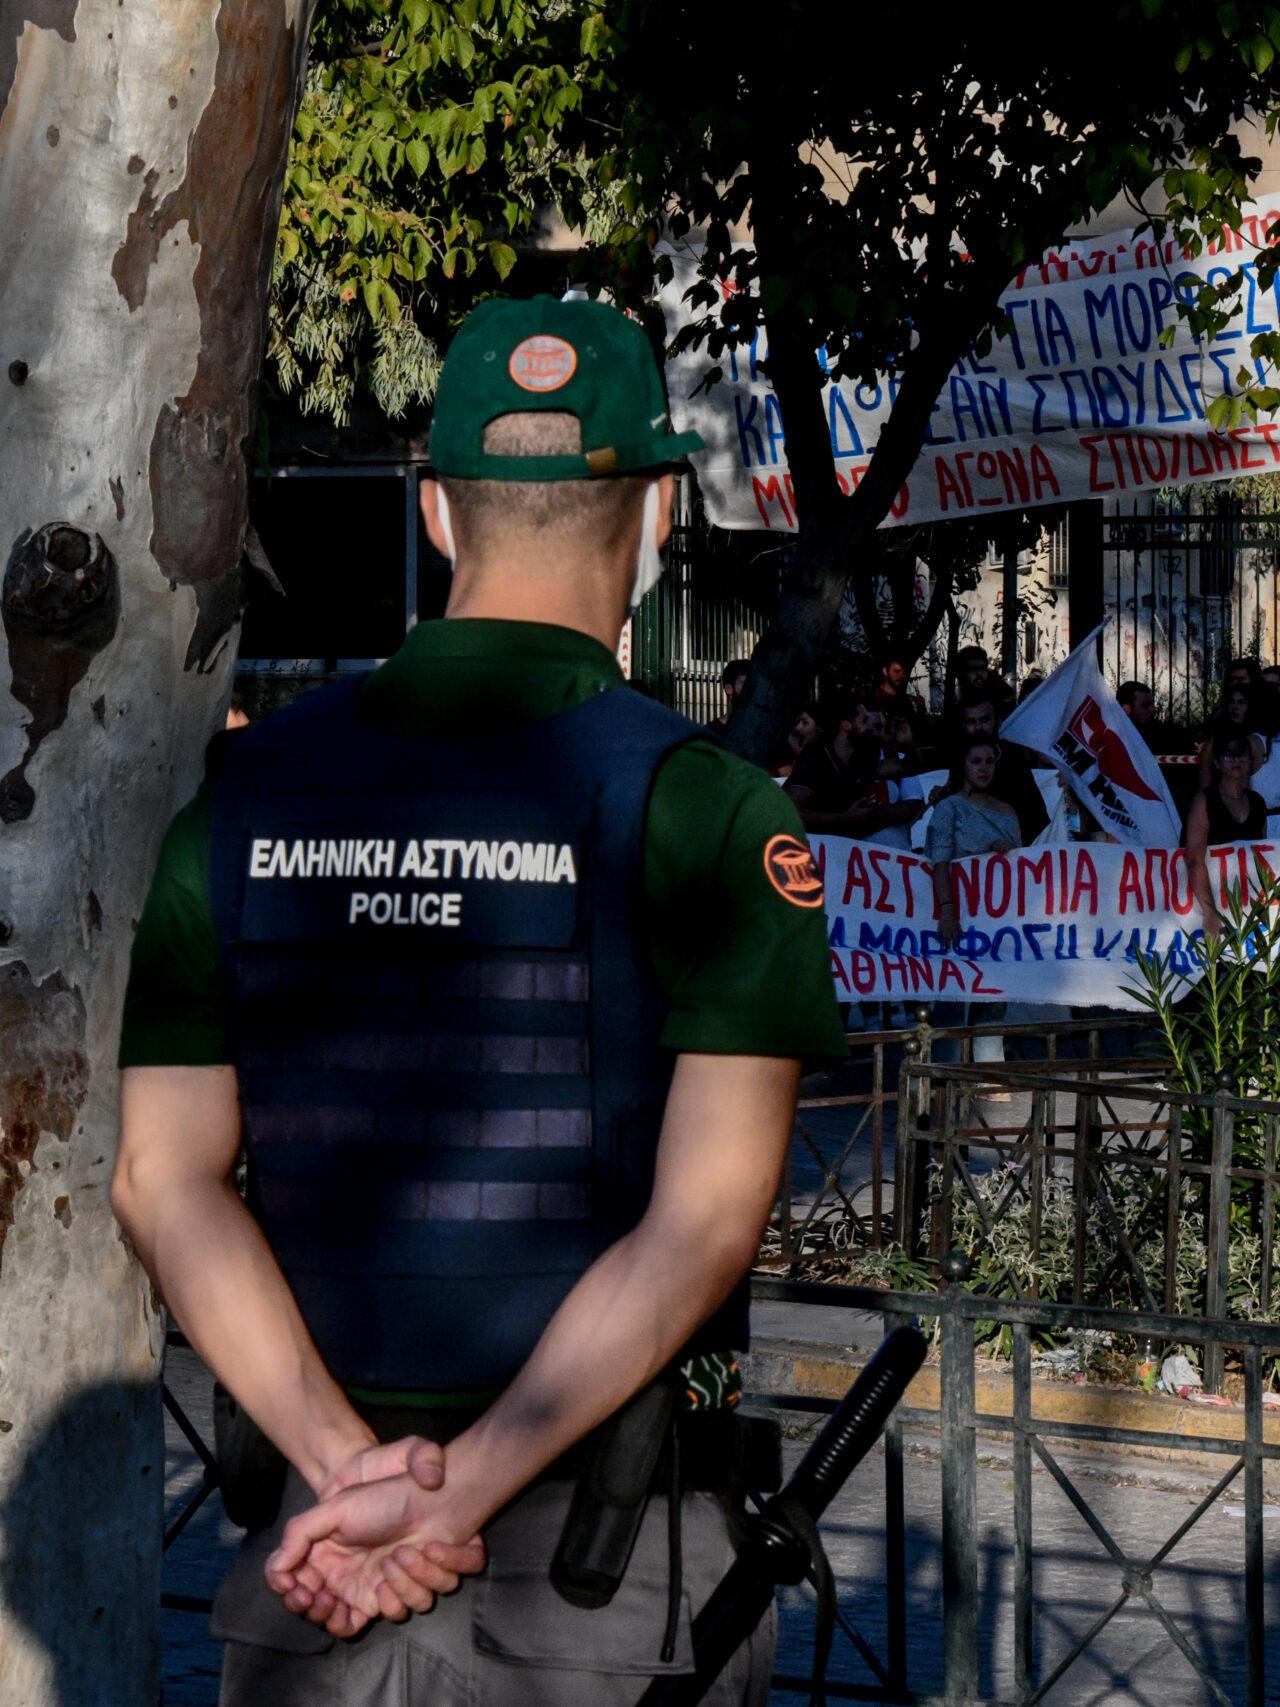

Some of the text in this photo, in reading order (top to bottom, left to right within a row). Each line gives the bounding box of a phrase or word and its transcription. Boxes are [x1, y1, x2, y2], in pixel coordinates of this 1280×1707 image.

[250, 839, 577, 884] ΕΛΛΗΝΙΚΗ ΑΣΤΥΝΟΜΙΑ
[1119, 847, 1195, 916] ΑΠΟ
[349, 893, 462, 926] POLICE
